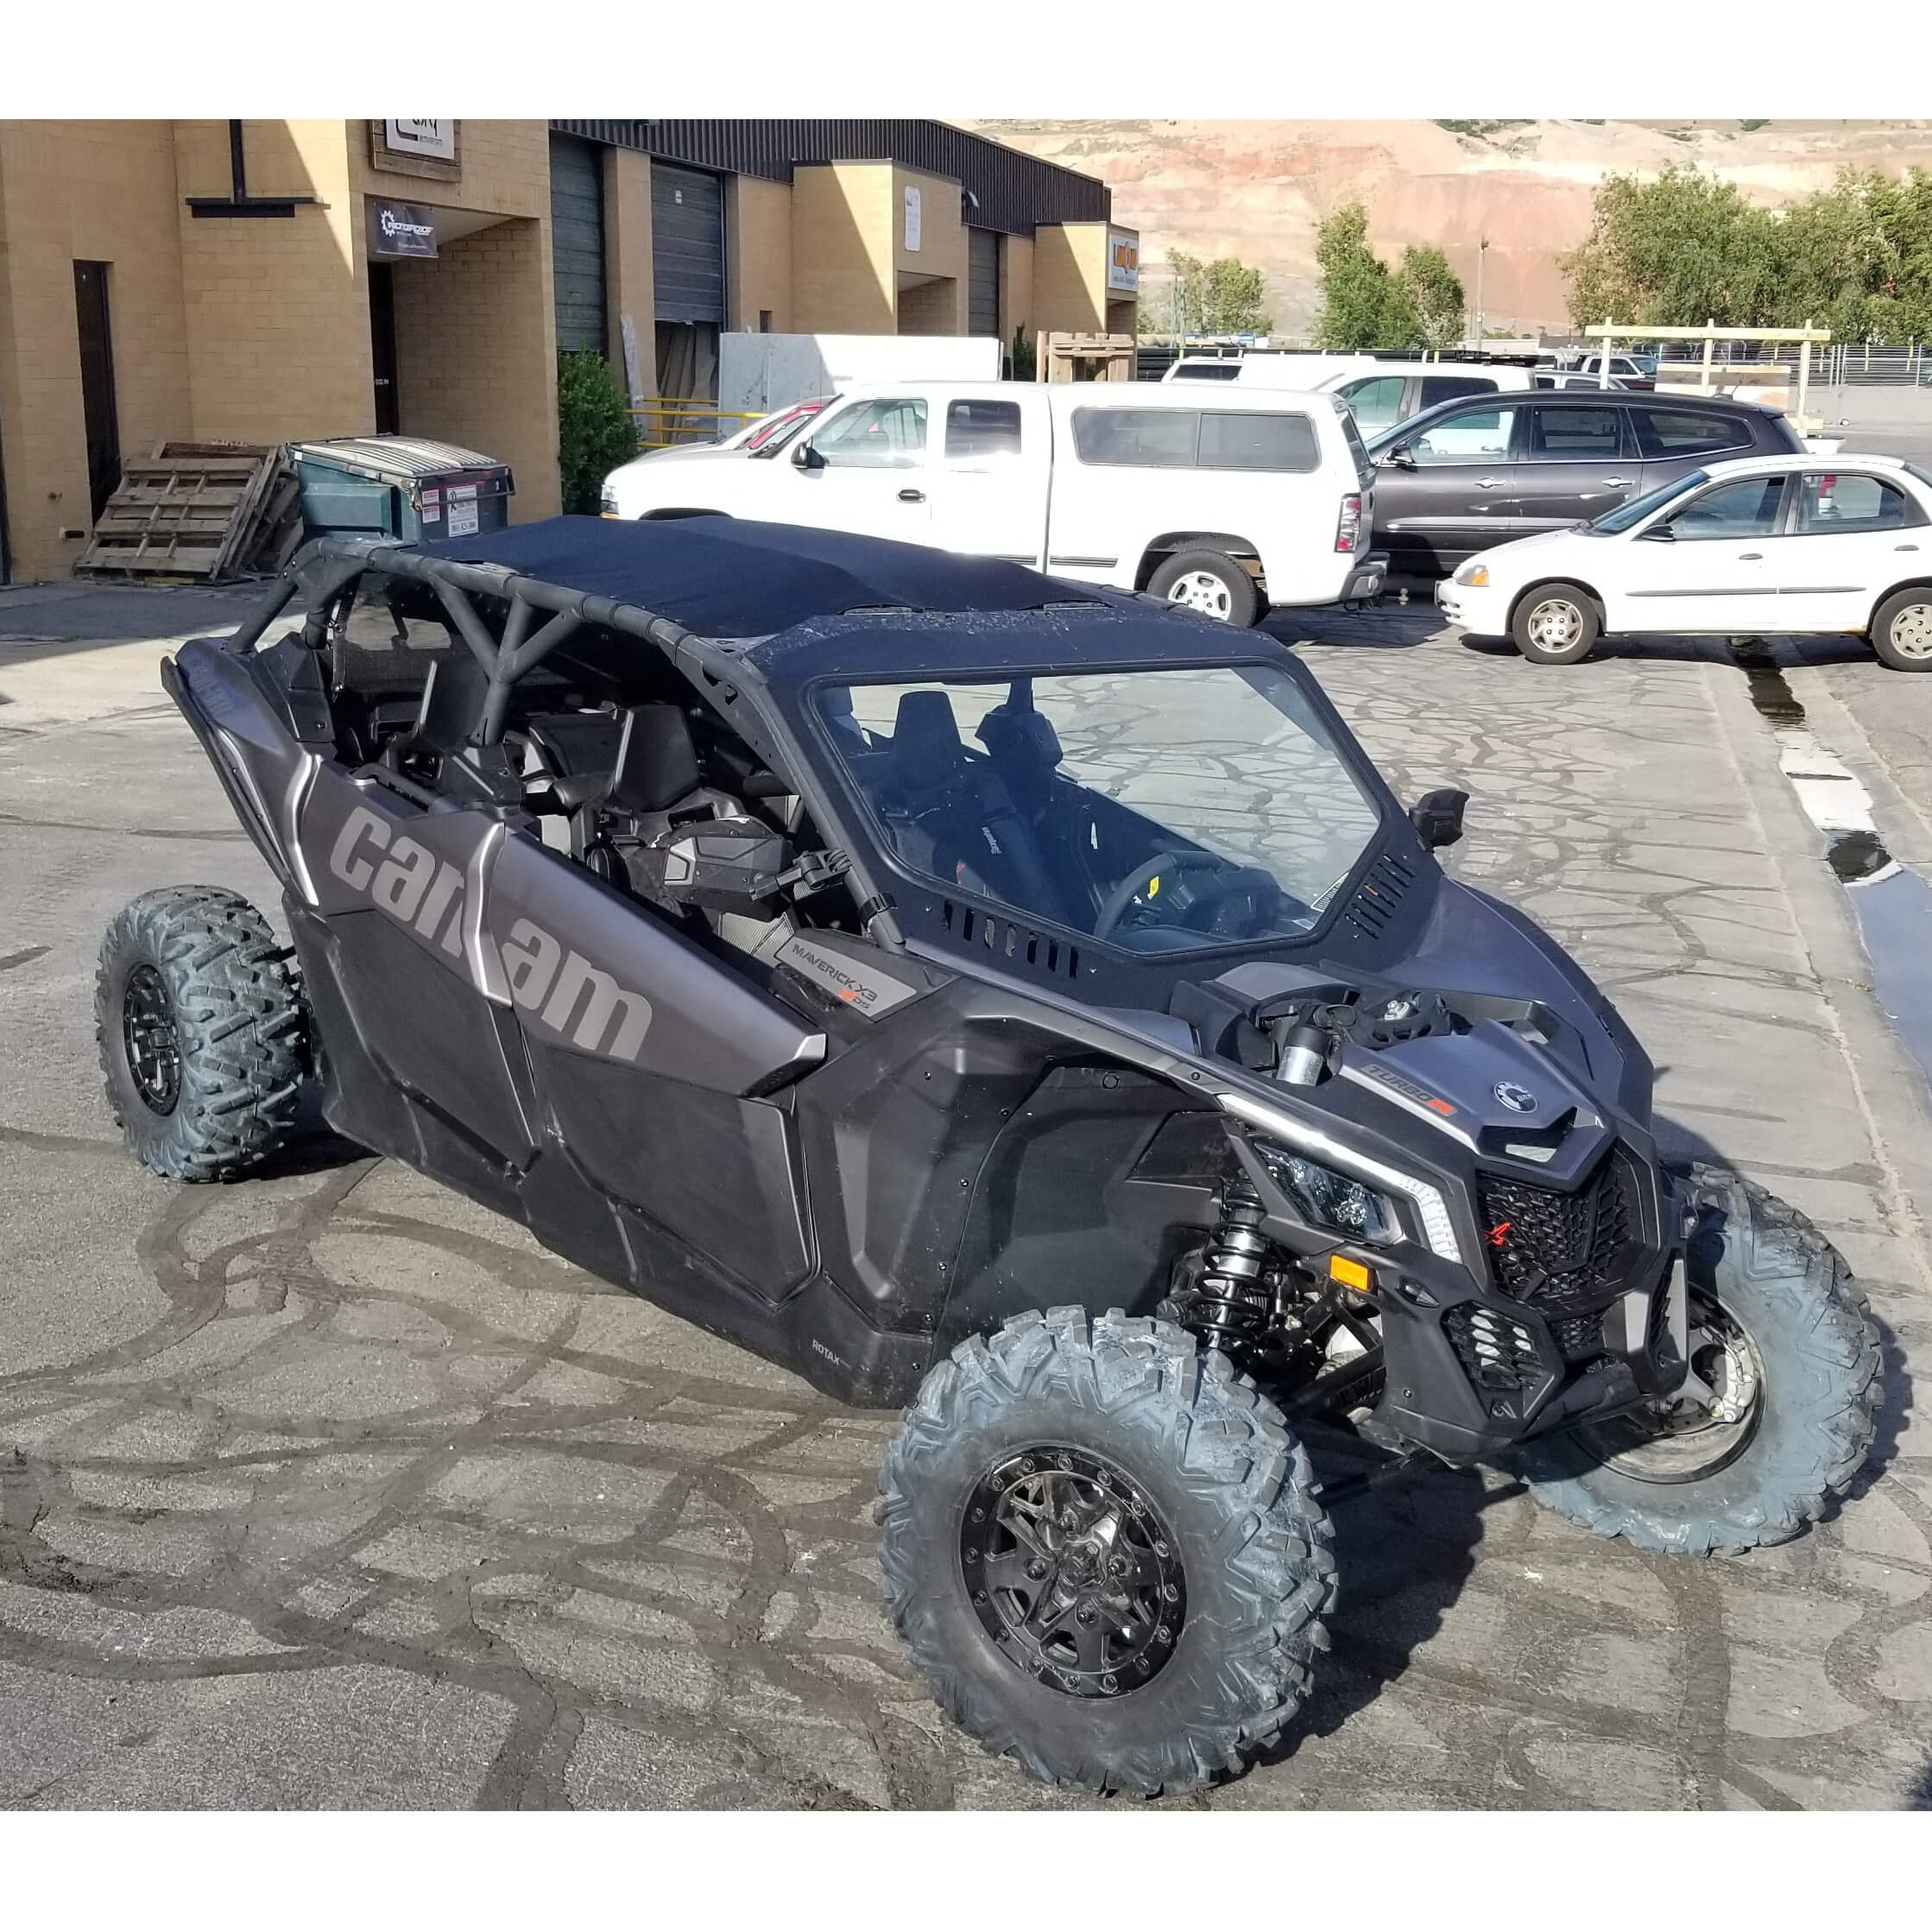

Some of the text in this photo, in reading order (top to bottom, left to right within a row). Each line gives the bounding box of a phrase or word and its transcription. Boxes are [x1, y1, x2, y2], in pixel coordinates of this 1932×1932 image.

[792, 944, 877, 1002] MAVERICK X3
[812, 1339, 840, 1365] ROTAX
